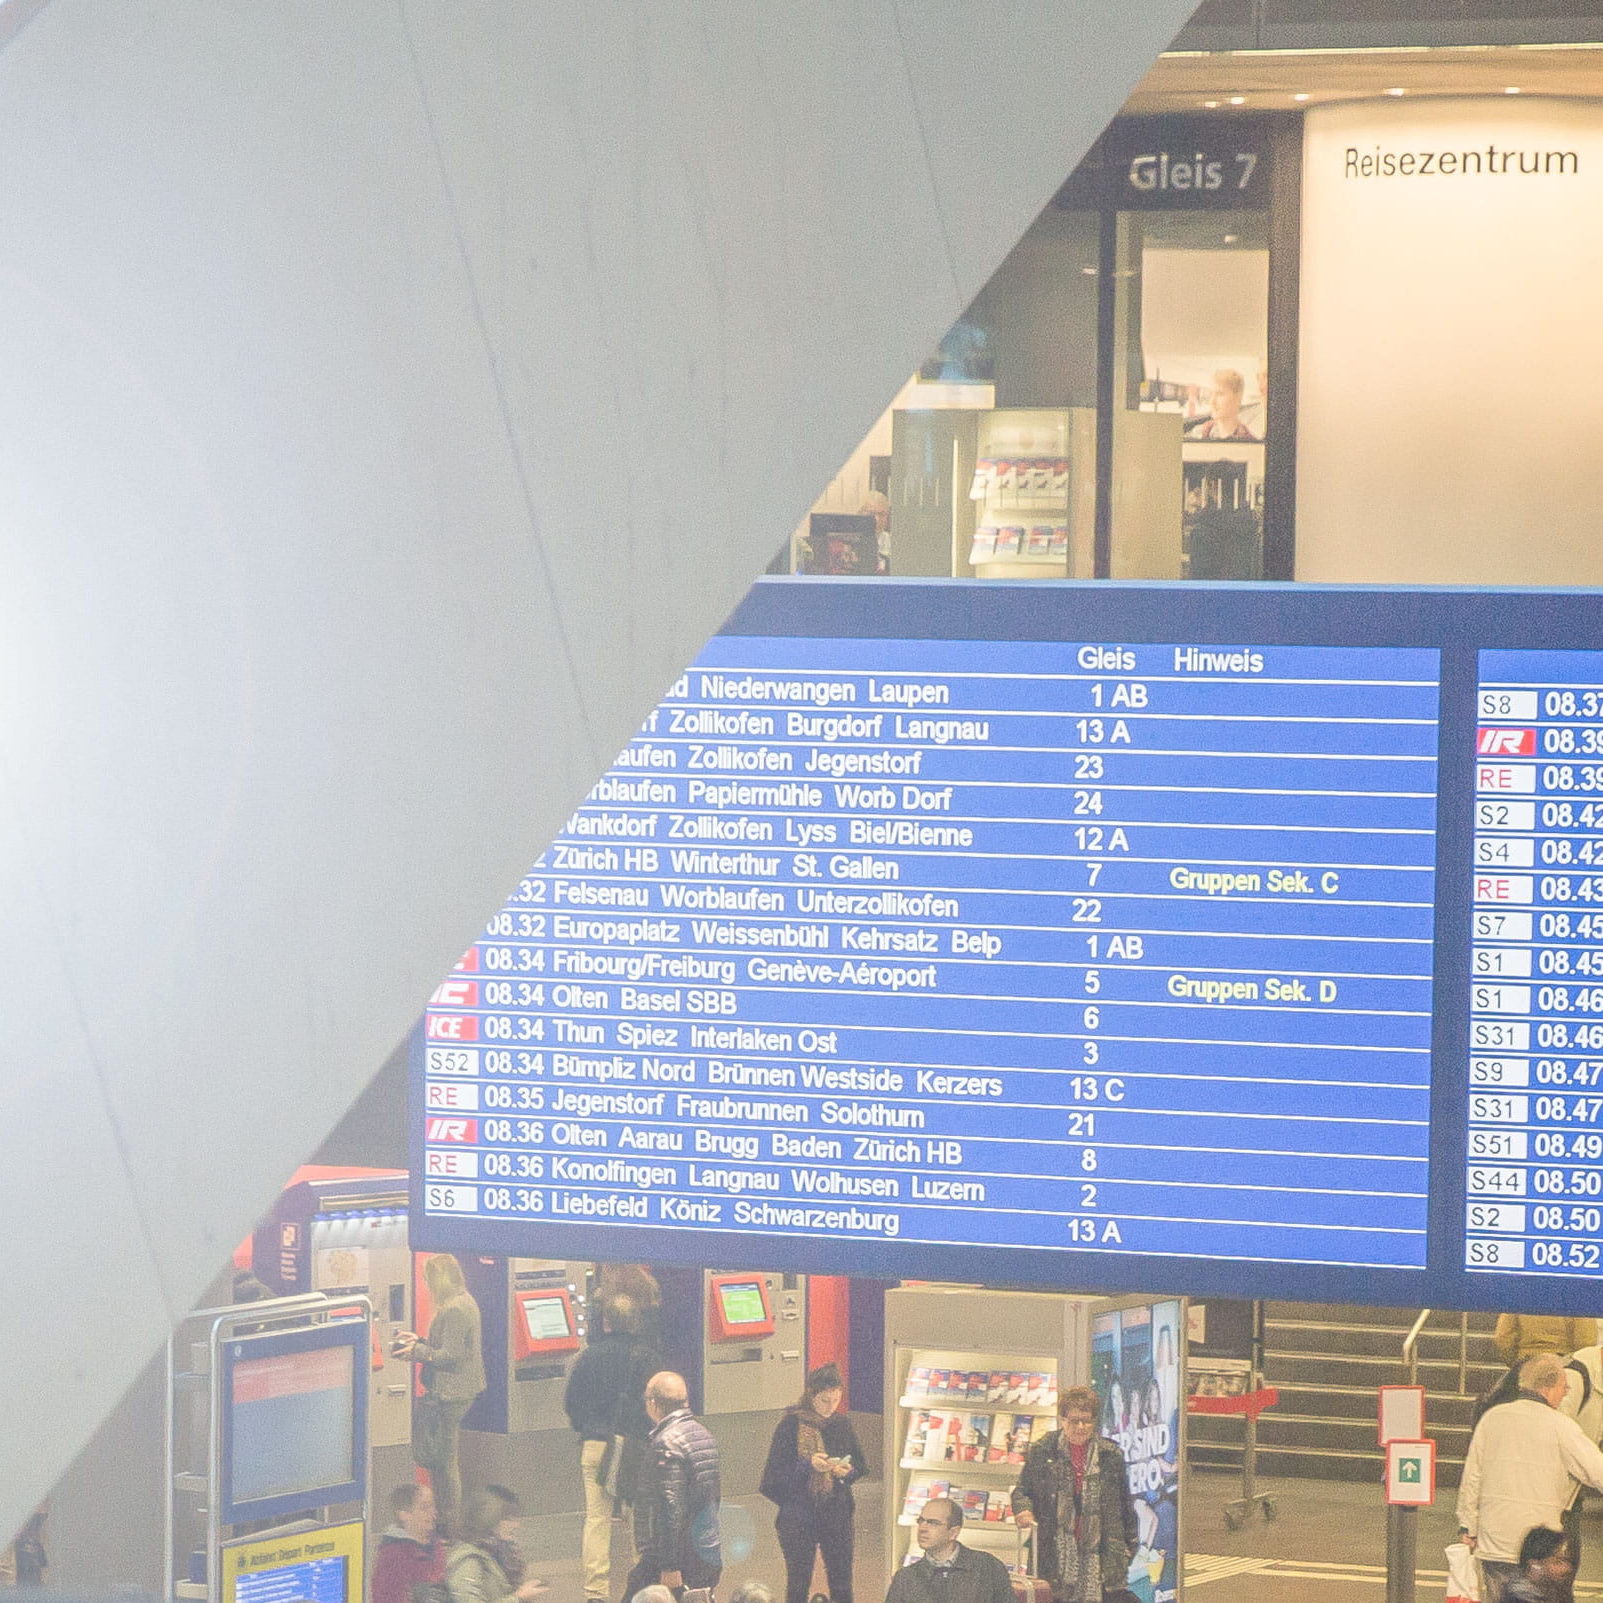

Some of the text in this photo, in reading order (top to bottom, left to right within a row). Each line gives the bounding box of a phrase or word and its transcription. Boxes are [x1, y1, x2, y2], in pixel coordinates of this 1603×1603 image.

[1128, 152, 1258, 190] Gleis 7
[1345, 145, 1580, 179] Reisezentrum
[1077, 645, 1135, 670] Gleis
[1173, 646, 1263, 672] Hinweis
[700, 674, 856, 705] Niederwangen
[868, 678, 949, 707] Laupen
[668, 708, 774, 735] Zollikofen
[786, 711, 883, 741] Burgdorf
[895, 714, 988, 744] Langnau
[613, 744, 922, 776] aufen Zollikofen Jegenstorf
[585, 777, 953, 810] rblaufen Papiermühle Worb Dorf
[667, 814, 772, 840] Zollikofen
[785, 818, 836, 846] Lyss
[849, 819, 972, 846] Biel/Bienne
[552, 844, 618, 870] Zürich
[623, 847, 659, 872] HB
[669, 849, 780, 876] Winterthur
[792, 853, 822, 877] St.
[829, 854, 899, 880] Gallen
[1169, 866, 1338, 895] Gruppen Sek. C
[553, 879, 648, 906] Felsenau
[659, 883, 784, 911] Worblaufen
[796, 888, 958, 917] Unterzollikofen
[553, 914, 1001, 958] Europaplatz Weissenbühl Kehrsatz Belp
[553, 949, 937, 990] Fribourg/Freiburg Genève-Aéroport
[551, 984, 737, 1014] Olten Basel SBB
[1167, 974, 1336, 1003] Gruppen Sek. D
[551, 1018, 837, 1053] Thun Spiez Interlaken Ost
[1474, 1024, 1515, 1046] S31
[429, 1049, 1002, 1096] S52 08.34 Bümpliz Nord Brünnen Westside Kerzers
[429, 1086, 924, 1128] RE Jegenstorf Fraubrunnen Solothurn
[550, 1122, 962, 1165] Olten Aarau Brugg Baden Zürich HB
[551, 1156, 985, 1201] Konolfingen Langnau Wolhusen Luzern
[1471, 1170, 1519, 1192] S44
[483, 1187, 899, 1236] 08.36 Liebefeld Köniz Schwarzenburg
[1531, 1241, 1600, 1268] 08.52
